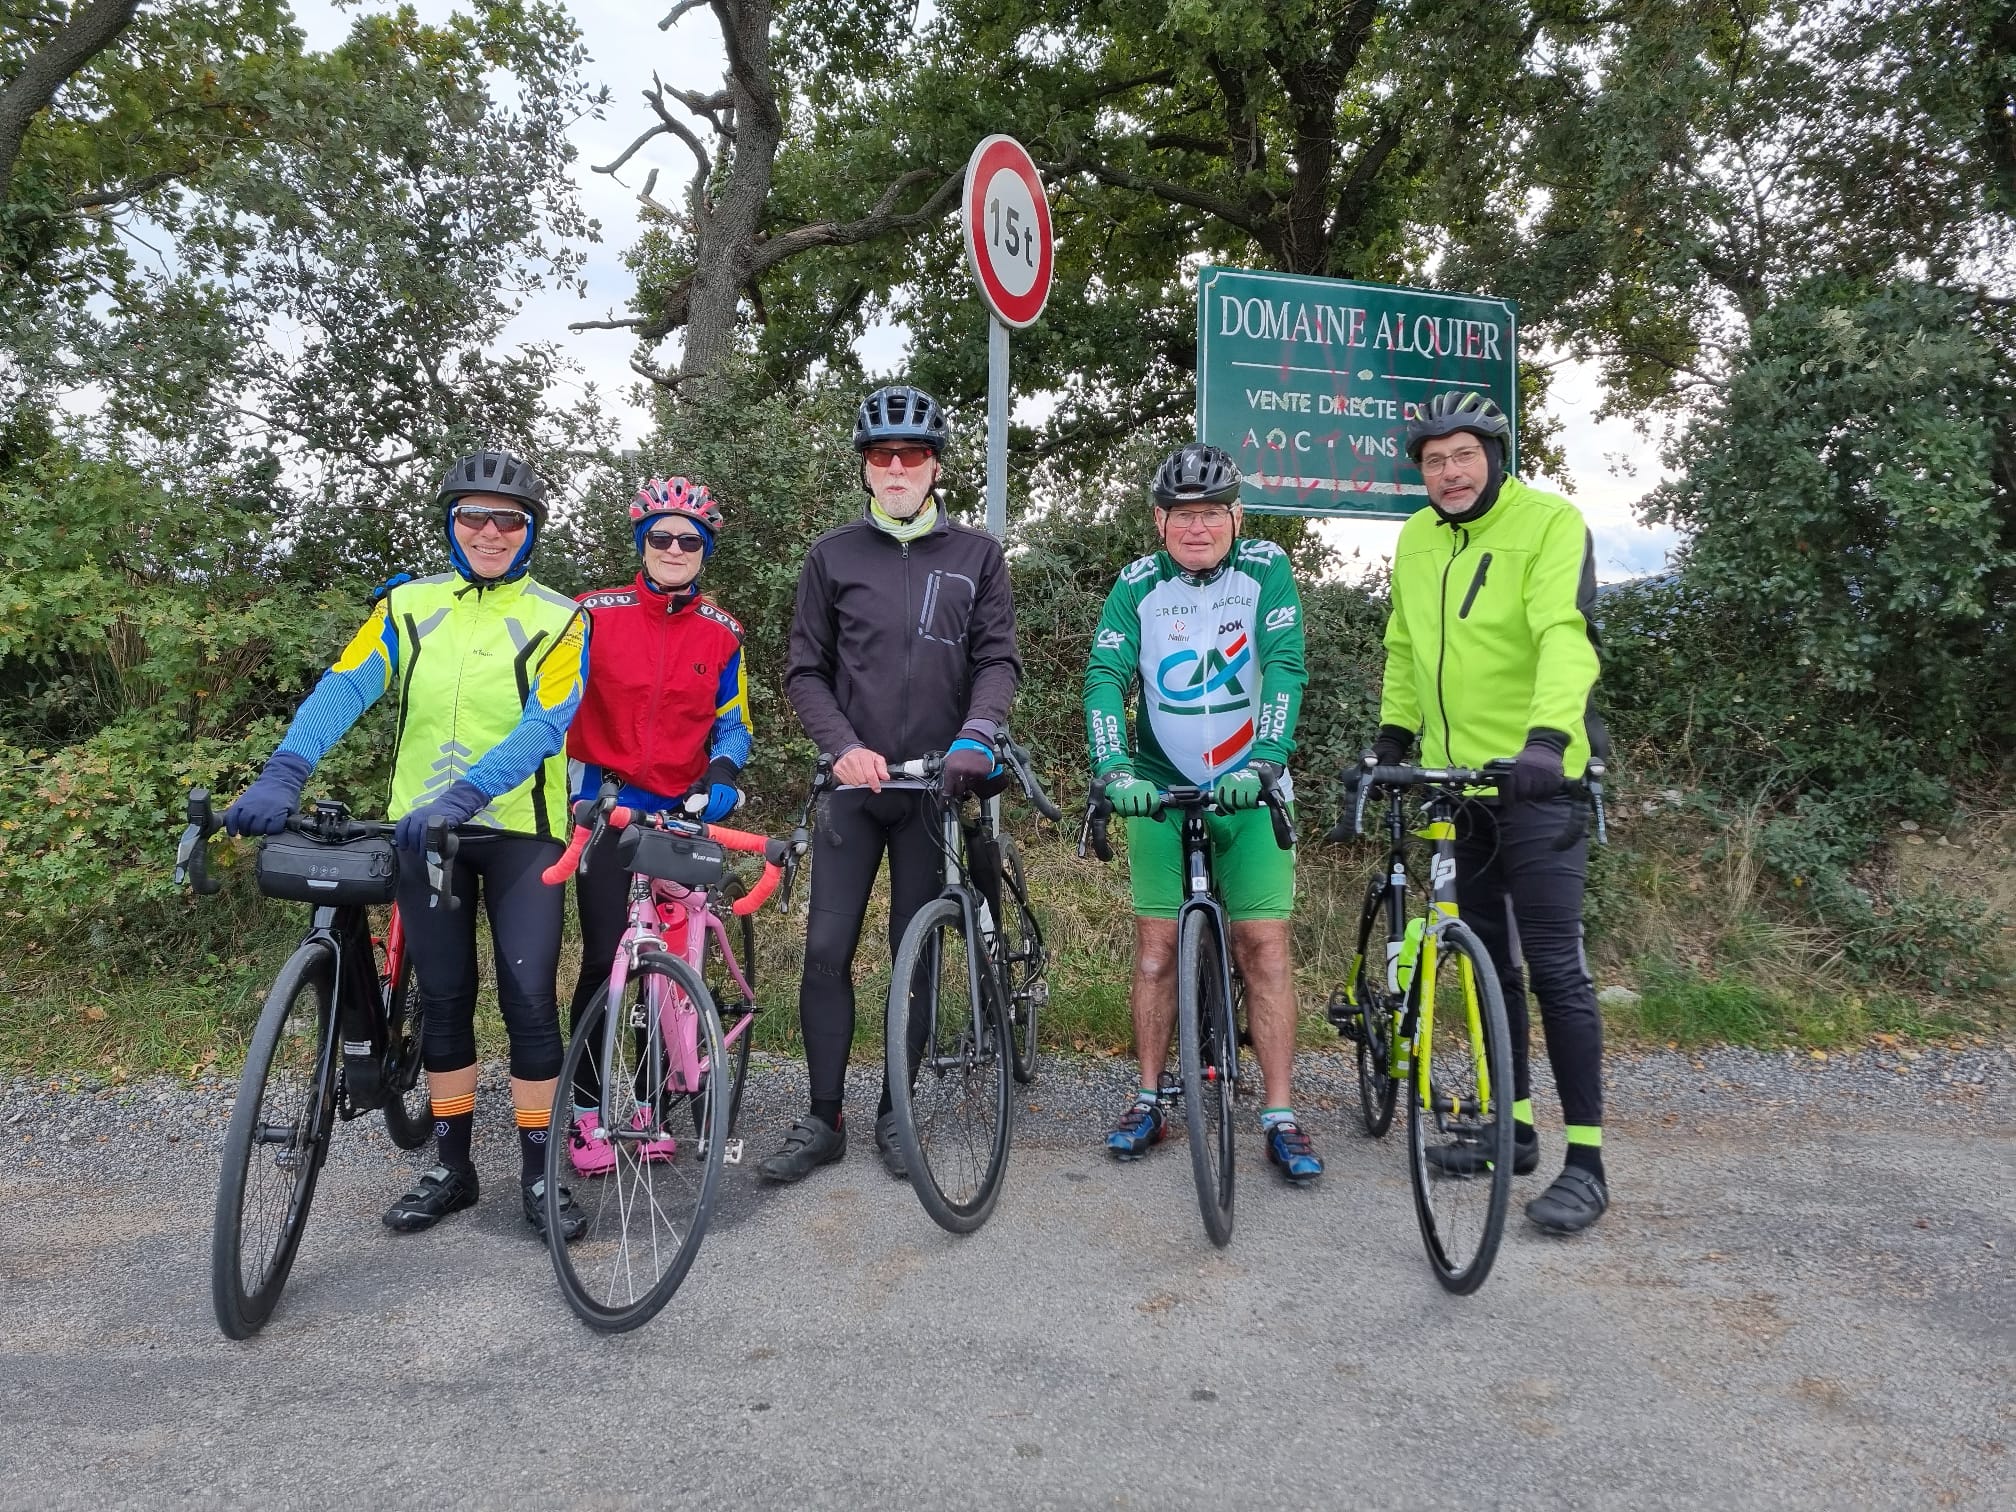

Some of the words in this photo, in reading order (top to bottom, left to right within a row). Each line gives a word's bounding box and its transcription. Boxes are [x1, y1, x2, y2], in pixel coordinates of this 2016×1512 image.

[990, 197, 1034, 268] 15t
[1219, 294, 1368, 348] DOMAINE
[1372, 311, 1503, 361] ALQUIER
[1245, 388, 1312, 414] VENTE
[1318, 393, 1398, 420] DIRECTE
[1403, 401, 1427, 421] D
[1348, 433, 1398, 458] VINS
[1217, 617, 1245, 636] OOK
[1259, 702, 1274, 741] REDIT
